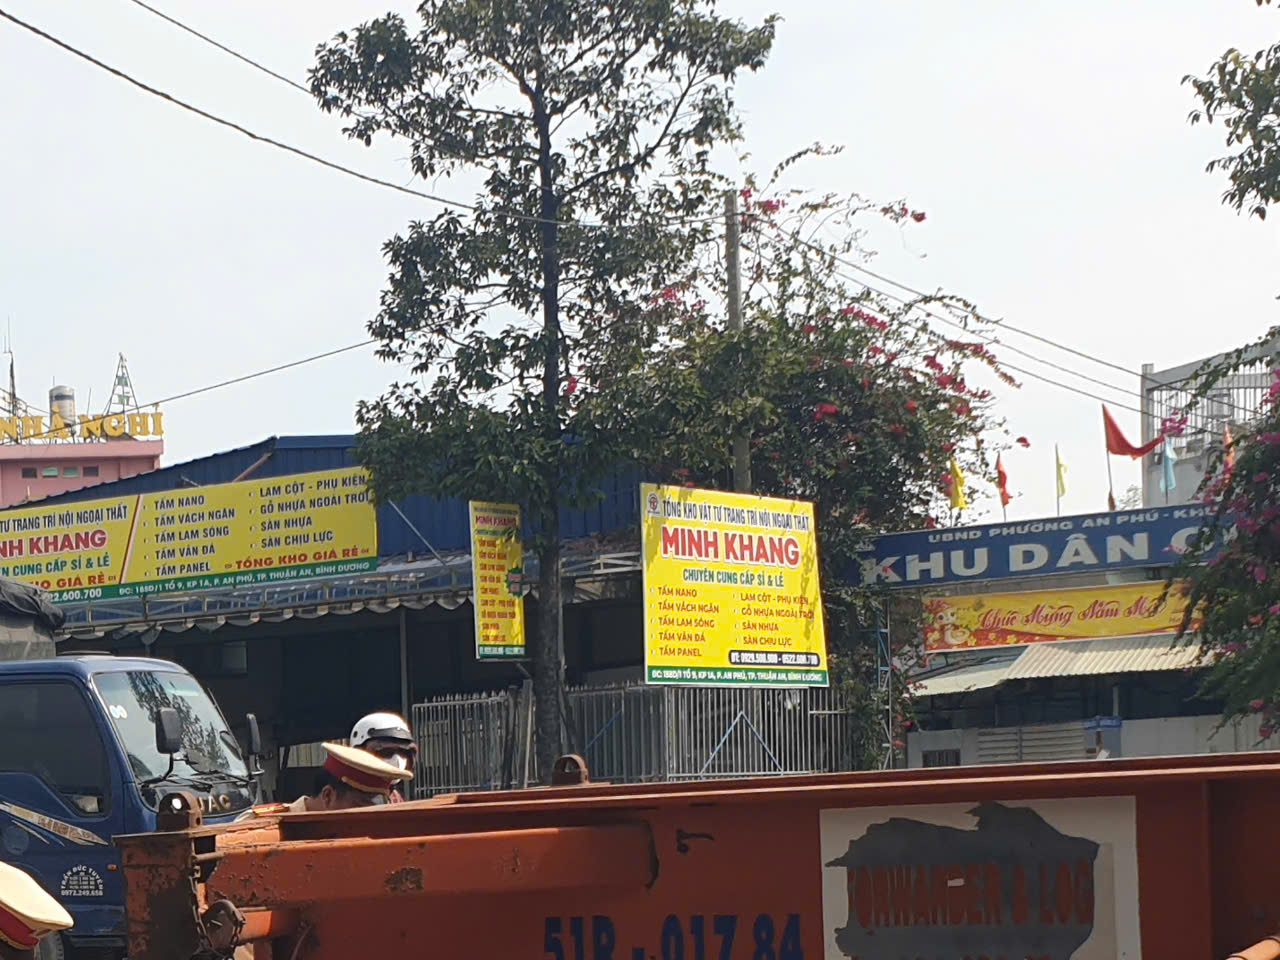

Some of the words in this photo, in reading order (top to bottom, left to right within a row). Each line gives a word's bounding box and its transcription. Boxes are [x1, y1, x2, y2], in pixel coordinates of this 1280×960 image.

[79, 404, 164, 439] NGHỈ
[260, 486, 281, 498] LAM
[285, 481, 305, 496] CỘT
[316, 479, 338, 492] PHỤ
[154, 496, 174, 511] TẤM
[178, 495, 205, 508] NANO
[277, 500, 306, 514] NHỰA
[0, 519, 12, 533] TƯ
[13, 517, 41, 532] TRANG
[59, 509, 74, 529] NỘI
[76, 510, 104, 527] NGOẠI
[106, 503, 128, 520] THẤT
[154, 513, 175, 527] TẤM
[179, 511, 205, 524] VÁCH
[663, 498, 681, 518] TỔNG
[683, 503, 697, 519] KHO
[699, 502, 711, 525] VẬT
[723, 508, 745, 526] TRANG
[284, 516, 312, 530] NHỰA
[928, 531, 982, 543] UBND
[988, 519, 1073, 537] PHƯỜNG
[1082, 516, 1111, 528] AN
[1116, 509, 1160, 525] PHÚ
[28, 529, 107, 555] KHANG
[155, 530, 175, 544] TẤM
[179, 530, 199, 541] LAM
[284, 533, 309, 547] CHỊU
[313, 530, 333, 544] LỰC
[155, 547, 175, 561] TẤM
[662, 527, 719, 559] MINH
[724, 532, 800, 566] KHANG
[236, 556, 274, 570] TỔNG
[278, 553, 308, 565] KHO
[313, 548, 337, 561] GIÁ
[862, 547, 989, 584] KHU
[1009, 532, 1149, 572] DÂN
[12, 560, 42, 577] CUNG
[45, 556, 67, 573] CẤP
[85, 557, 94, 569] &
[155, 563, 176, 577] TẤM
[180, 562, 210, 575] PANEL
[56, 574, 83, 589] GIÁ
[683, 567, 714, 582] CHUYÊN
[716, 570, 738, 584] CUNG
[739, 568, 755, 585] CẤP
[675, 588, 697, 598] NANO
[741, 593, 756, 601] LAM
[676, 618, 693, 627] LAM
[677, 647, 702, 657] PANEL
